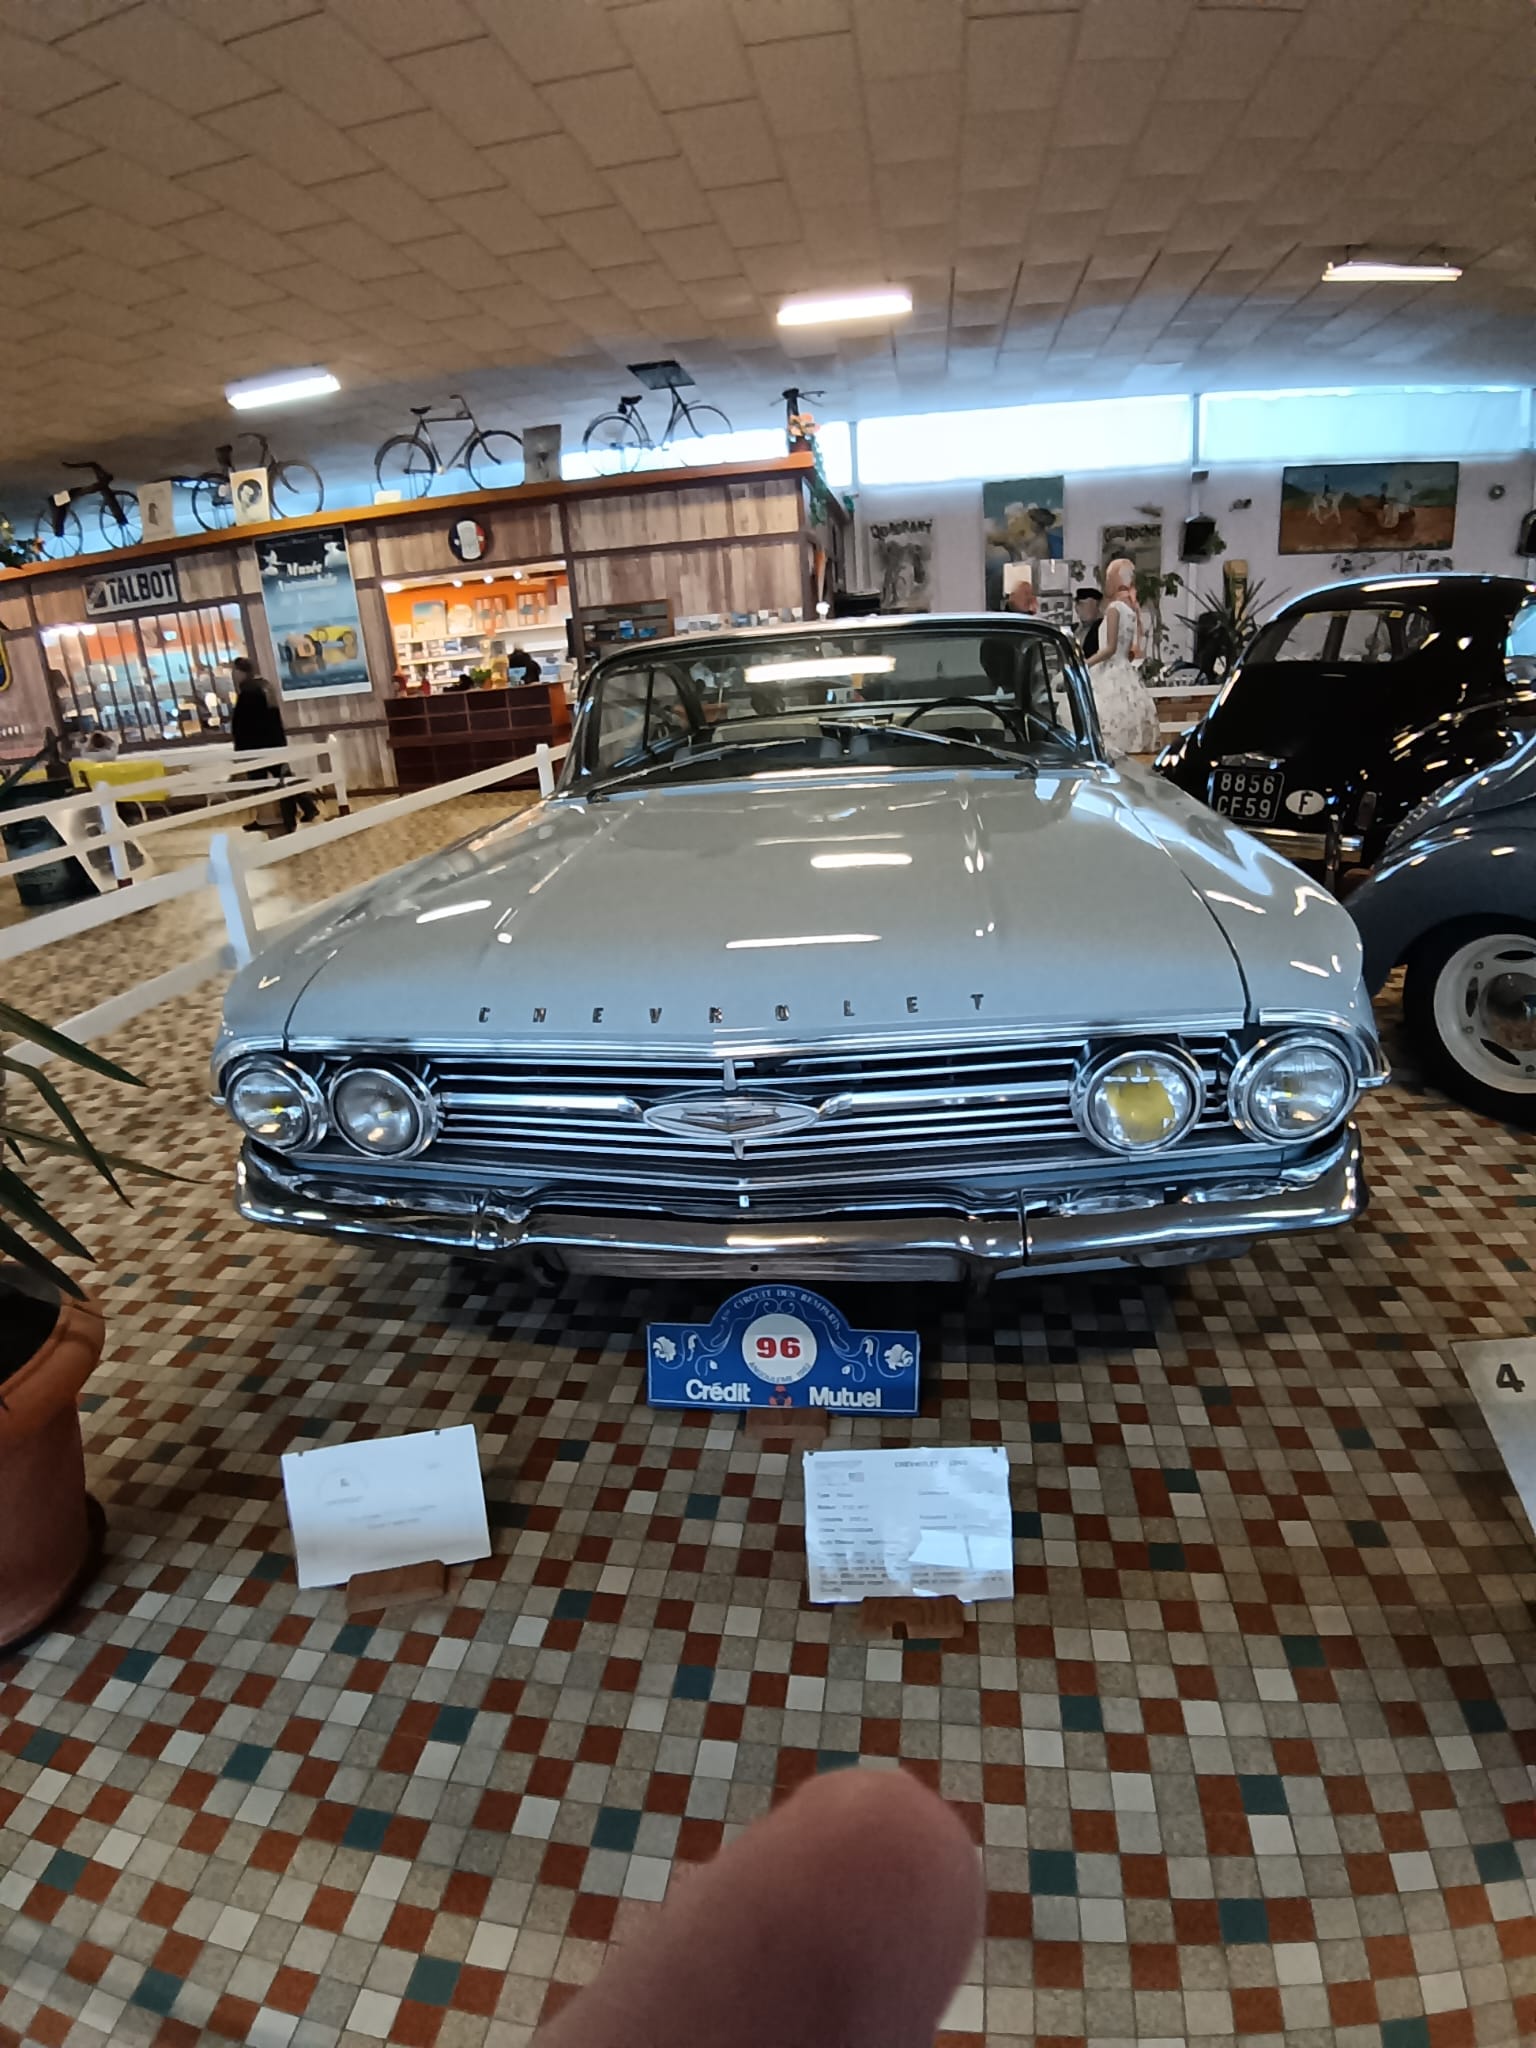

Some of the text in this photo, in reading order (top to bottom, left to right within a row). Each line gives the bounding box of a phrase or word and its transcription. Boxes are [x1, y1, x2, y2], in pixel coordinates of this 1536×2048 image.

[106, 569, 174, 605] TALBOT
[1220, 772, 1275, 795] 8856
[1298, 791, 1314, 813] F
[478, 993, 985, 1025] CHEVROLET
[776, 1288, 797, 1299] DES
[756, 1336, 801, 1359] 96
[1496, 1363, 1526, 1393] 4
[685, 1378, 882, 1408] Crédit Mutuel
